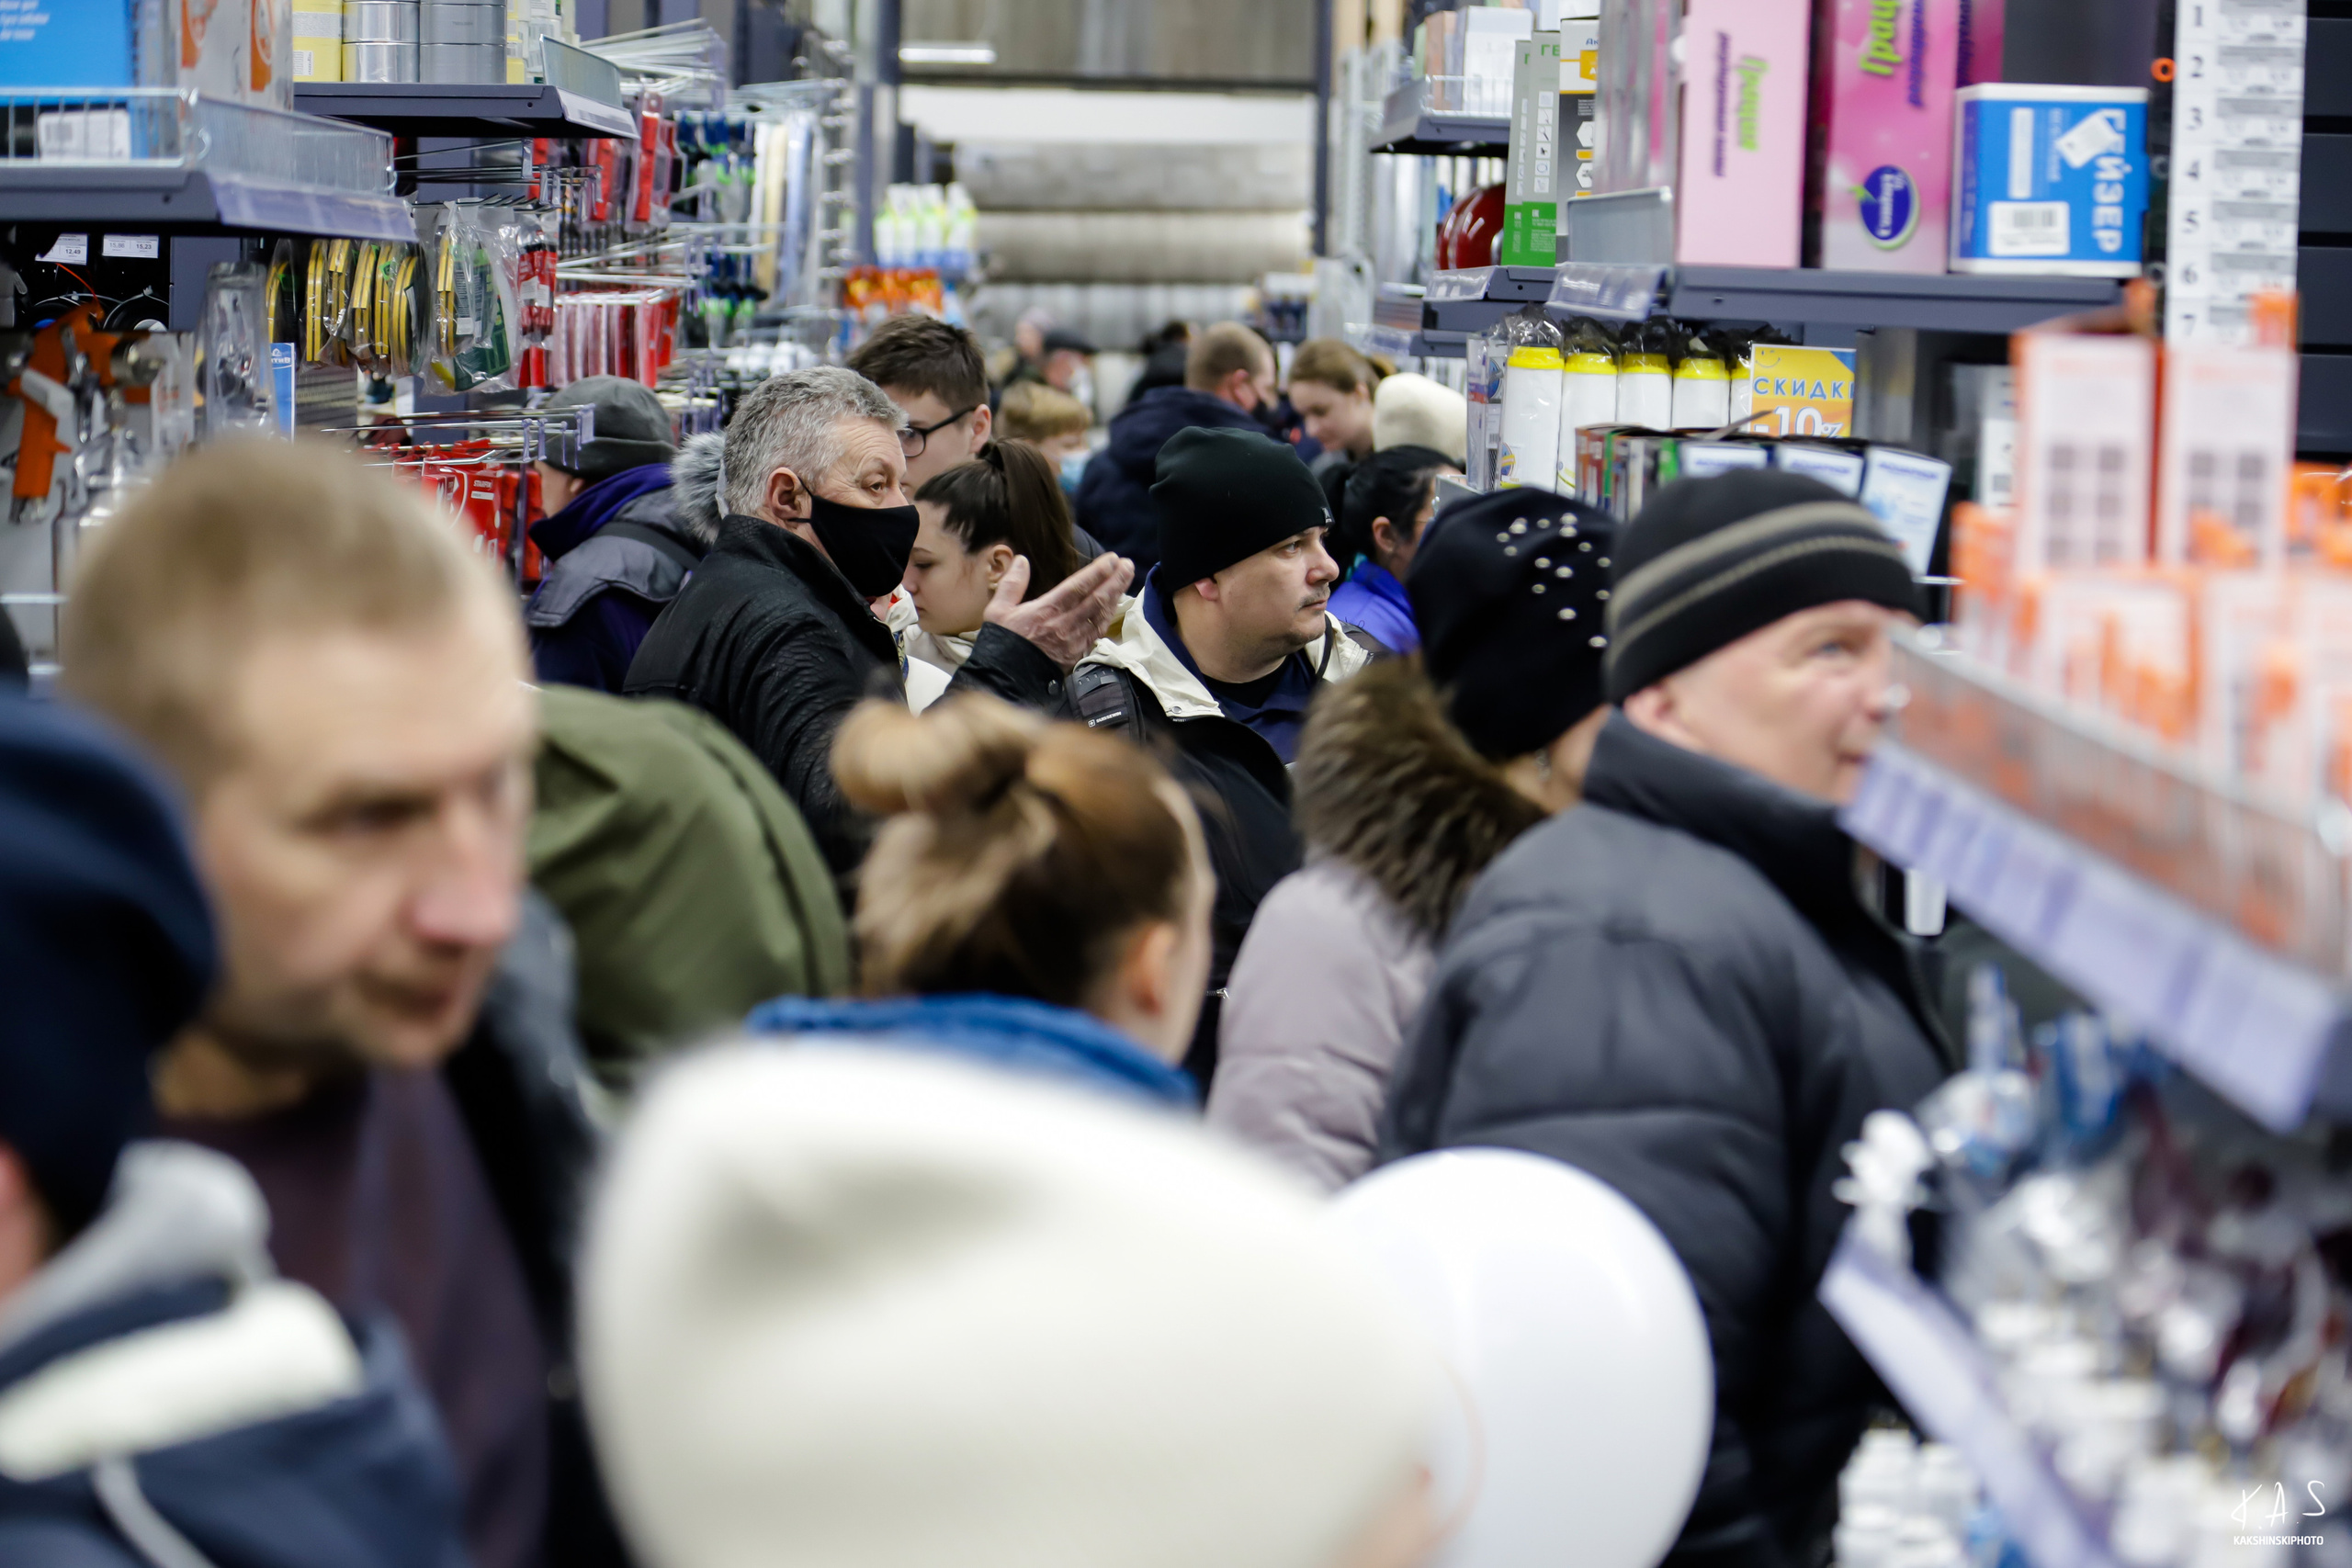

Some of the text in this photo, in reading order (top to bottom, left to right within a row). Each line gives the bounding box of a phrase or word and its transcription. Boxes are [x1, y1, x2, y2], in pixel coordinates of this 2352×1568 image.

[2194, 5, 2202, 28] 1
[2190, 54, 2203, 78] 2
[2187, 107, 2202, 130] 3
[2186, 158, 2200, 181] 4
[2182, 209, 2199, 233] 5
[2180, 262, 2199, 286] 6
[2181, 313, 2196, 338] 7
